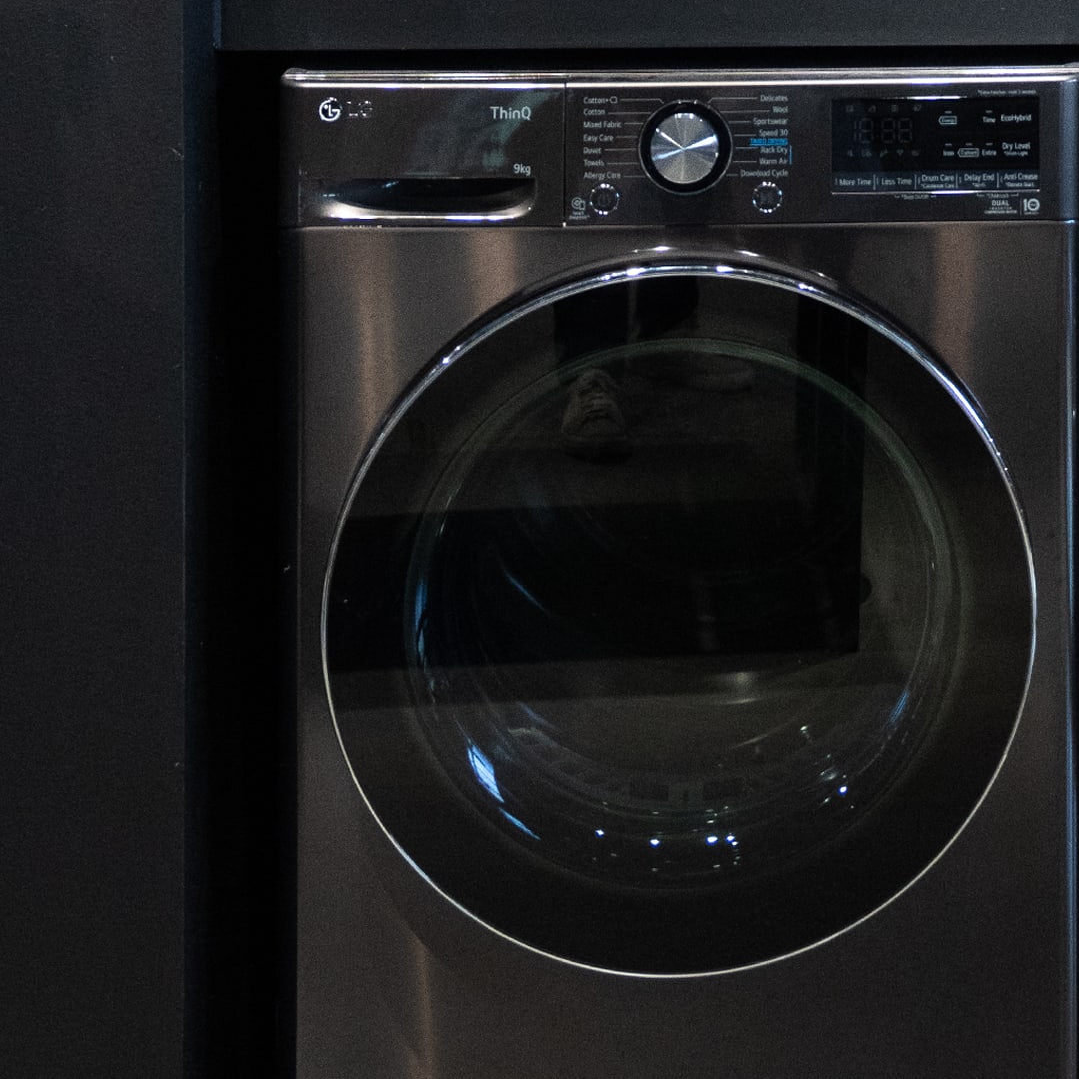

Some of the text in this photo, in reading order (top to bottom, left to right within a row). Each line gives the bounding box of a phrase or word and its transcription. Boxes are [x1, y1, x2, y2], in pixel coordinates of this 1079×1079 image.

[489, 105, 532, 120] ThinQ
[583, 108, 606, 116] Cotton
[752, 117, 788, 126] Sportswear
[1000, 113, 1032, 123] EcoHybrid
[759, 129, 778, 137] Speed
[583, 134, 598, 143] Easy
[1002, 142, 1031, 151] Dry Level
[981, 149, 997, 157] Extra
[583, 159, 604, 167] Towels
[759, 157, 788, 165] Warm Air
[513, 163, 531, 176] 9kg
[740, 169, 789, 178] Download Cycle
[583, 171, 621, 181] Allergy Care
[921, 173, 955, 182] Drum Care
[964, 173, 995, 183] Delay End
[896, 177, 913, 185] Time
[1023, 198, 1041, 212] 10
